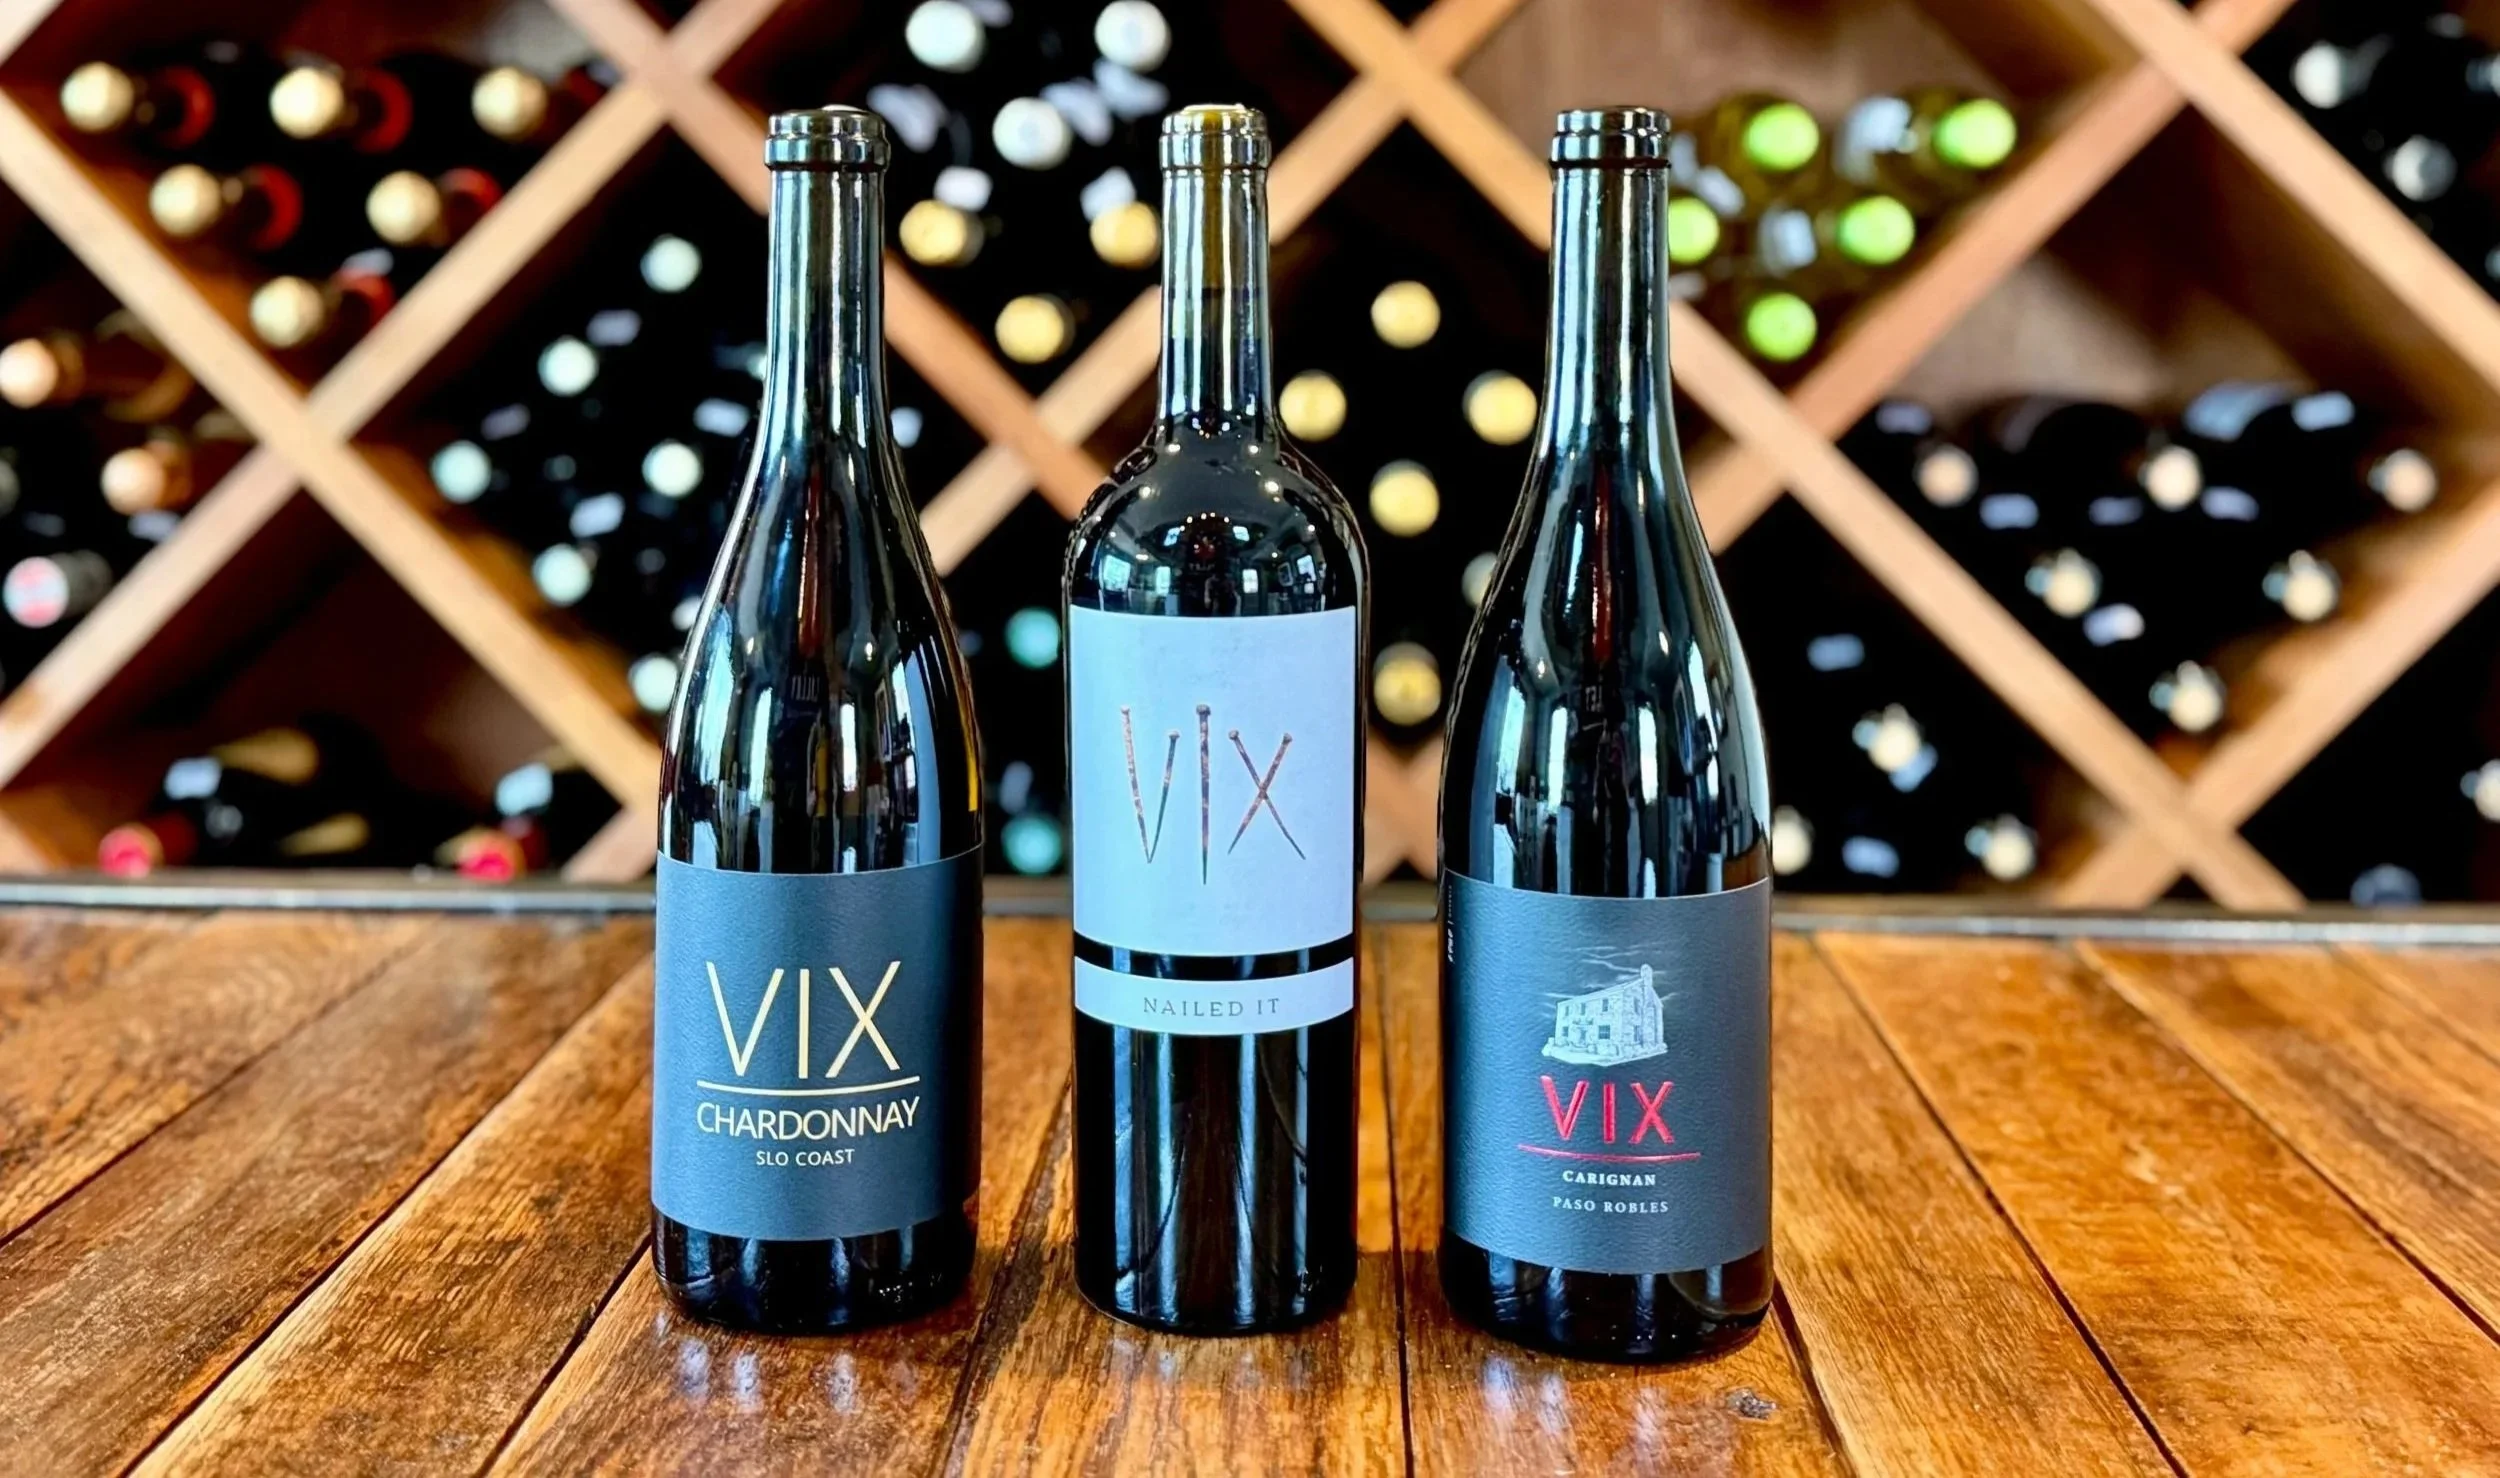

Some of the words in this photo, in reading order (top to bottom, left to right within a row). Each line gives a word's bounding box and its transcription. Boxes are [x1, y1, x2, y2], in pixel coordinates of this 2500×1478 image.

[1120, 703, 1306, 885] VIX
[706, 961, 901, 1079] VIX
[1143, 997, 1244, 1018] NAILED
[1256, 998, 1280, 1014] IT
[697, 1096, 920, 1140] CHARDONNAY
[1539, 1075, 1674, 1145] VIX
[756, 1149, 789, 1166] SLO
[796, 1148, 855, 1166] COAST
[1562, 1170, 1656, 1186] CARIGNAN
[1552, 1196, 1595, 1212] PASO
[1603, 1199, 1669, 1214] ROBLES
